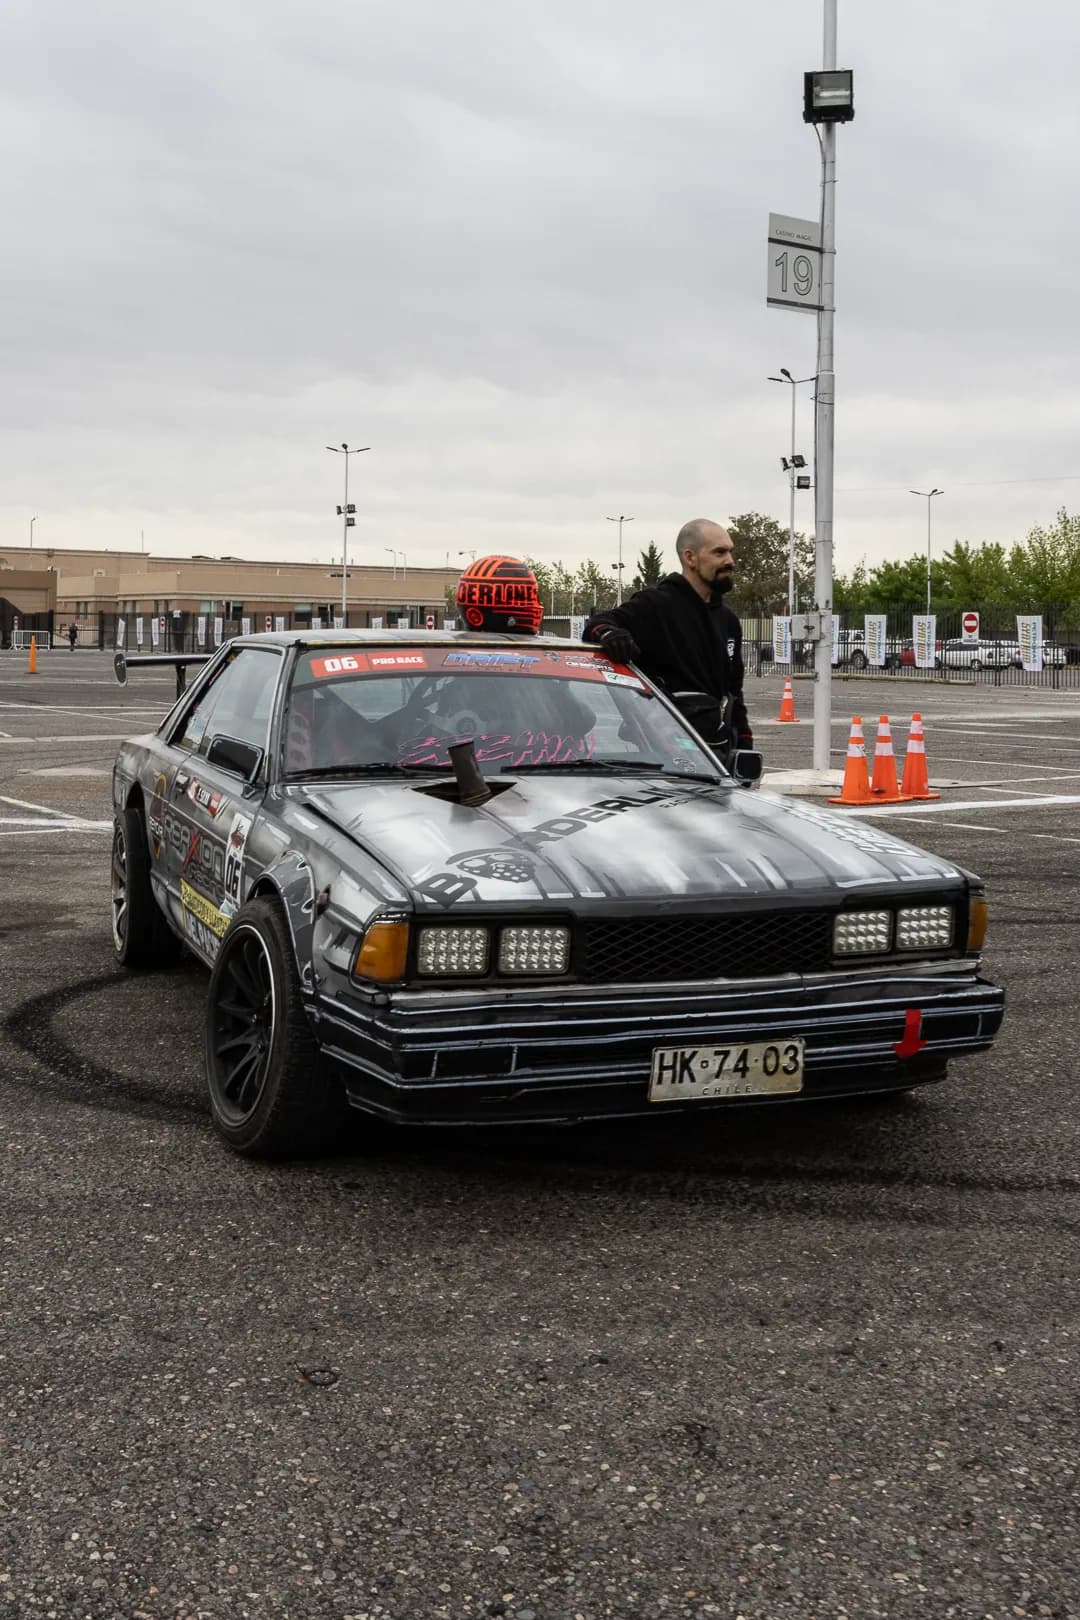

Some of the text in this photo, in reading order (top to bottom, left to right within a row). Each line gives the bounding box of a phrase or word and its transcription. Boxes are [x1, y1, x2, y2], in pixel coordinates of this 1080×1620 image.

[775, 251, 813, 296] 19
[324, 656, 359, 672] 06
[396, 656, 424, 664] RACE
[656, 1044, 800, 1085] HK 74 03
[702, 1084, 753, 1096] CHILE
